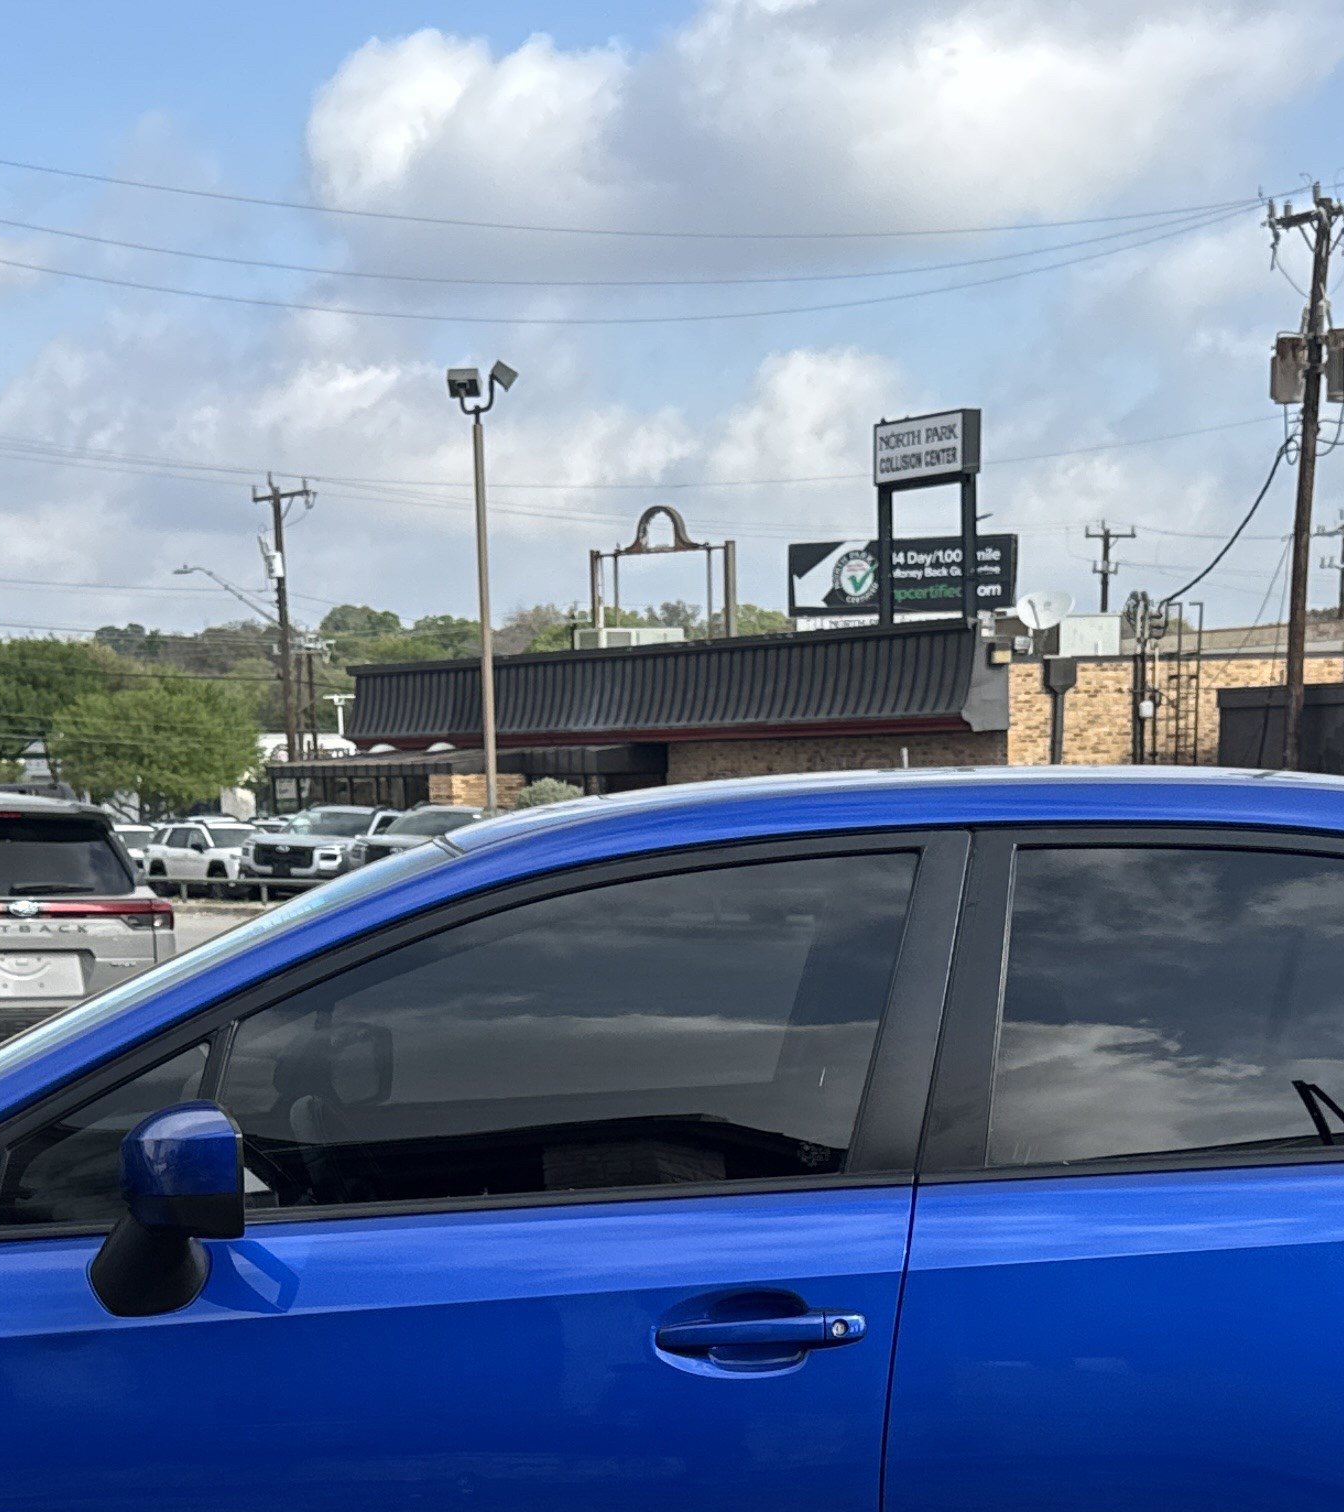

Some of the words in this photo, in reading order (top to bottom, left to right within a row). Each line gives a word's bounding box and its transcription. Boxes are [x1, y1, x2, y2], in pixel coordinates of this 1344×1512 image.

[879, 430, 922, 451] NORTH
[925, 423, 958, 443] PARK
[880, 452, 922, 474] COLLISION
[924, 446, 957, 467] CENTER
